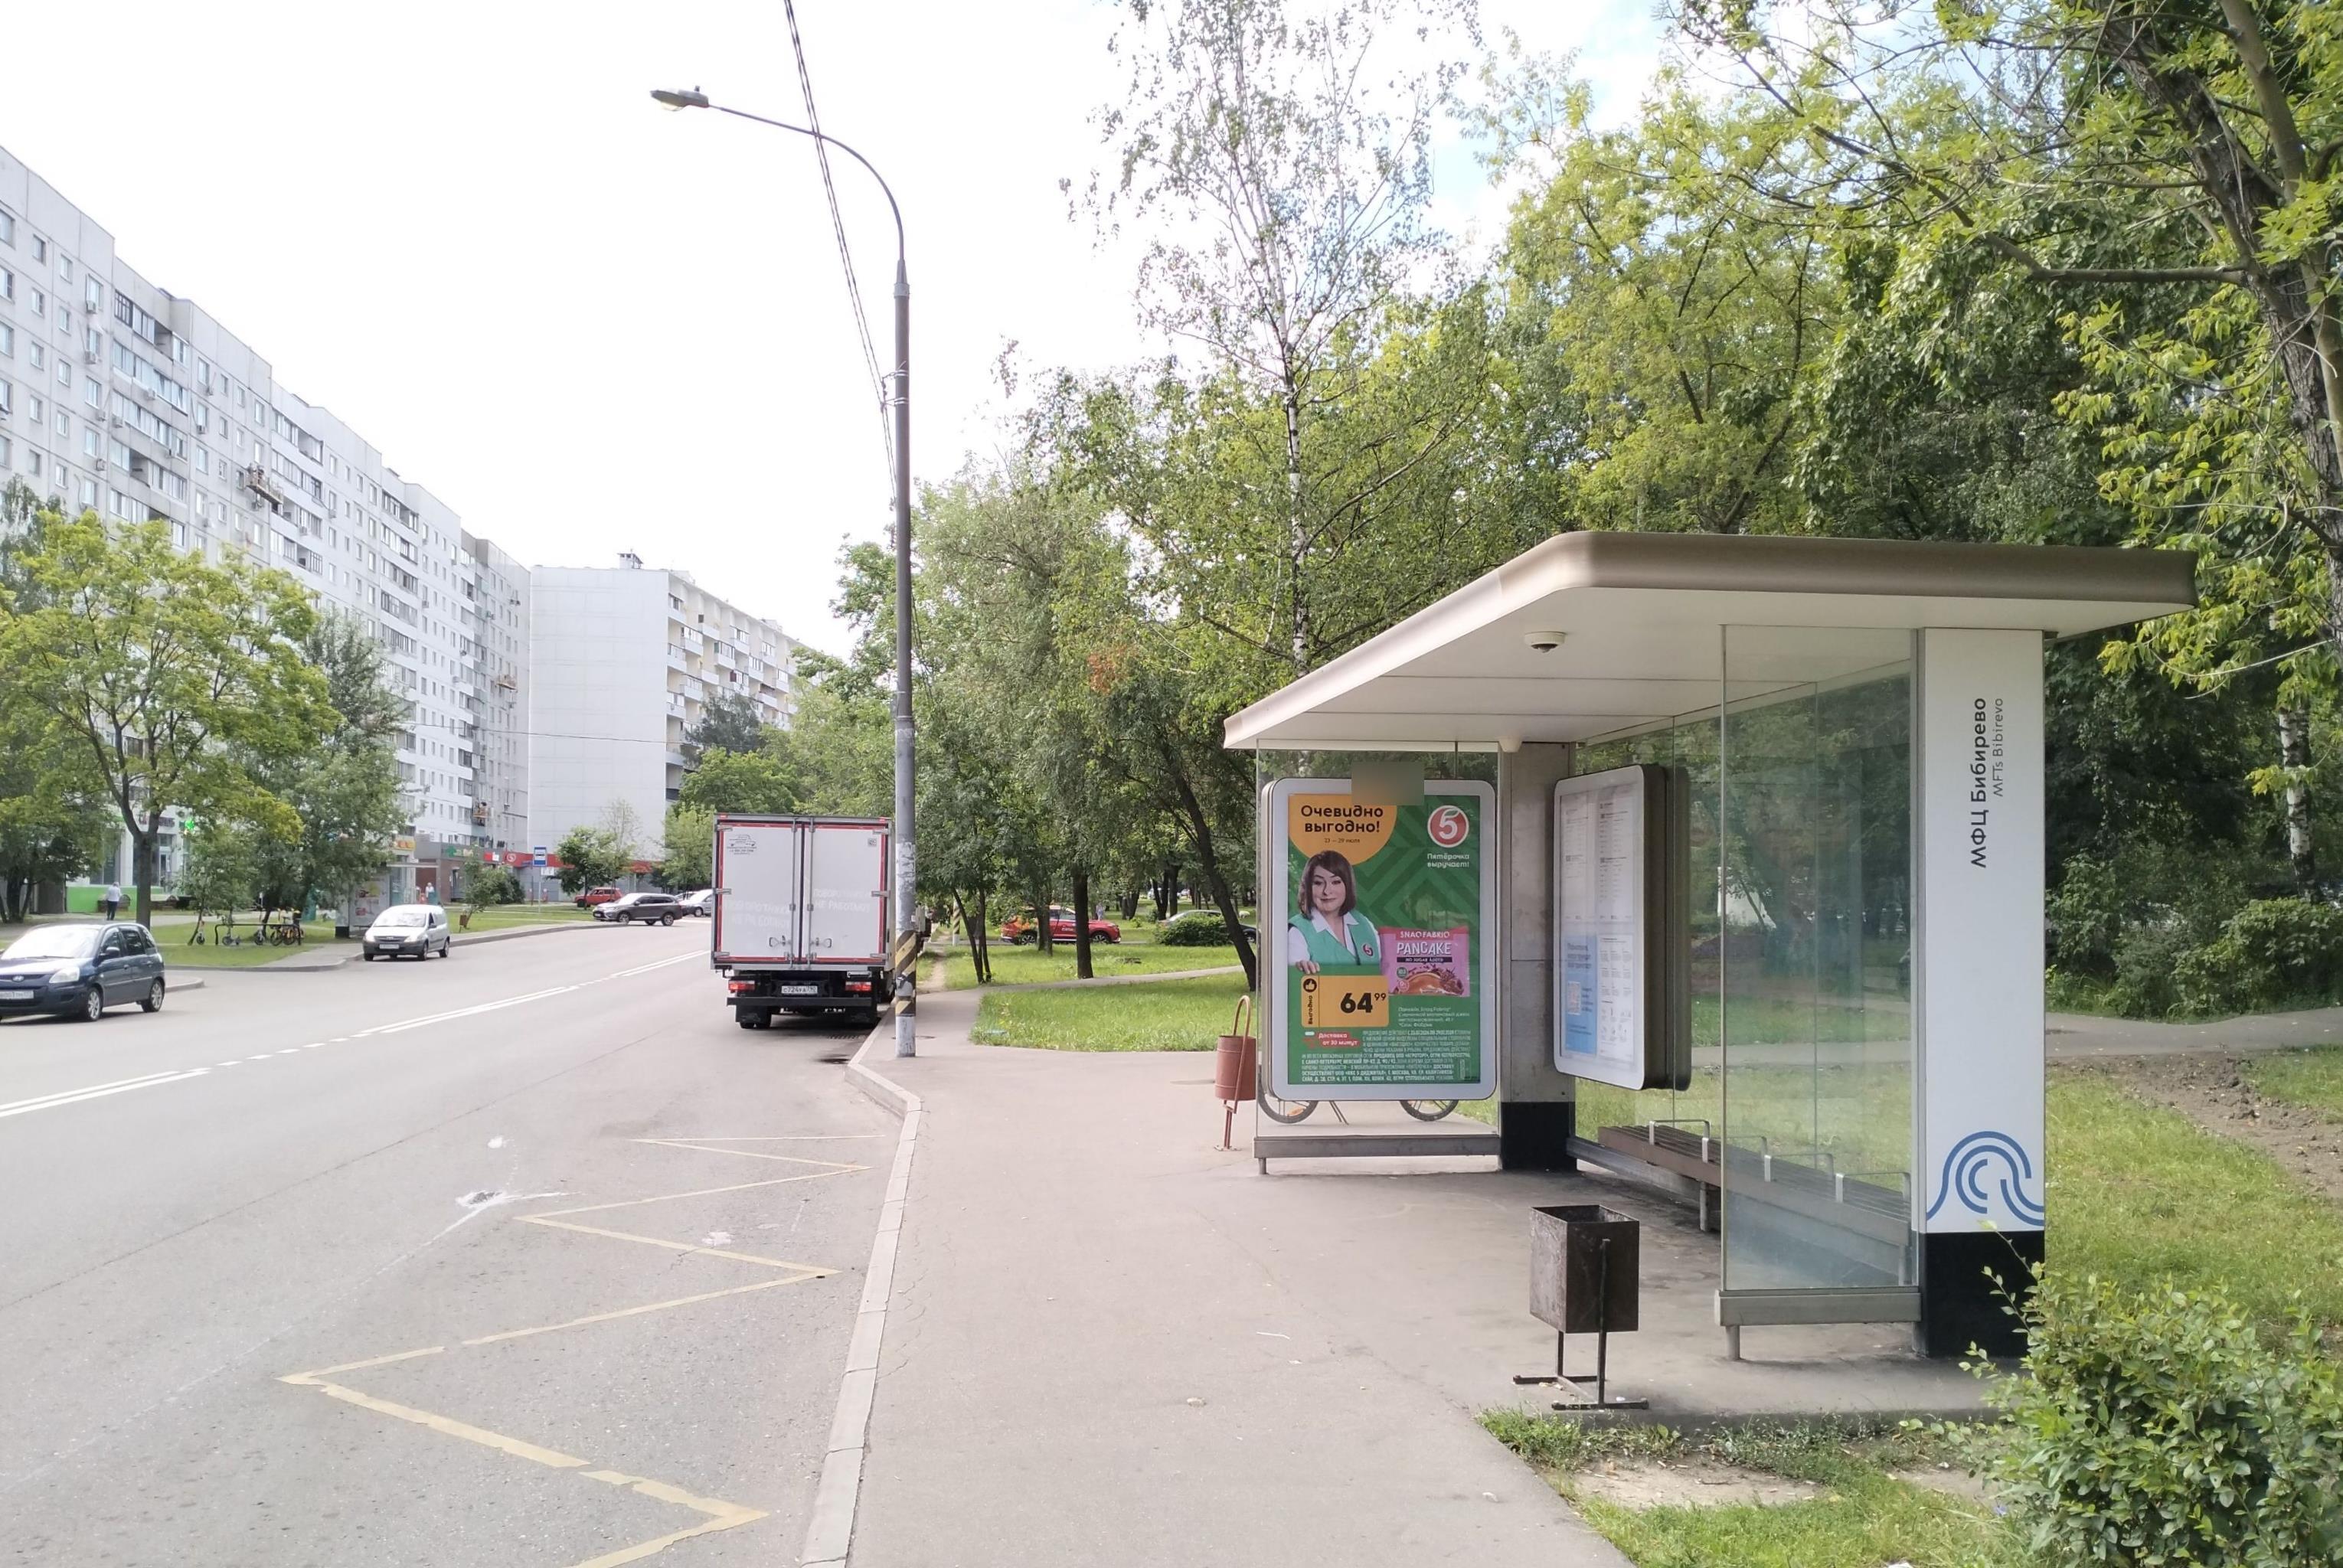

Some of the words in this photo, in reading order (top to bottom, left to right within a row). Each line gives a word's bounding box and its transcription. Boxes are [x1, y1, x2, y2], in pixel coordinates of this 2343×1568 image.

[1992, 697, 2003, 756] Bibirevo
[1970, 697, 1990, 802] Бибирево
[1992, 762, 2003, 797] MFTs
[1301, 805, 1384, 818] Очевидно
[1305, 820, 1381, 833] выгодно!
[1970, 809, 1989, 868] МФЦ
[1396, 942, 1452, 956] PANCAKE
[1340, 992, 1373, 1014] 64
[1374, 992, 1387, 1001] 99
